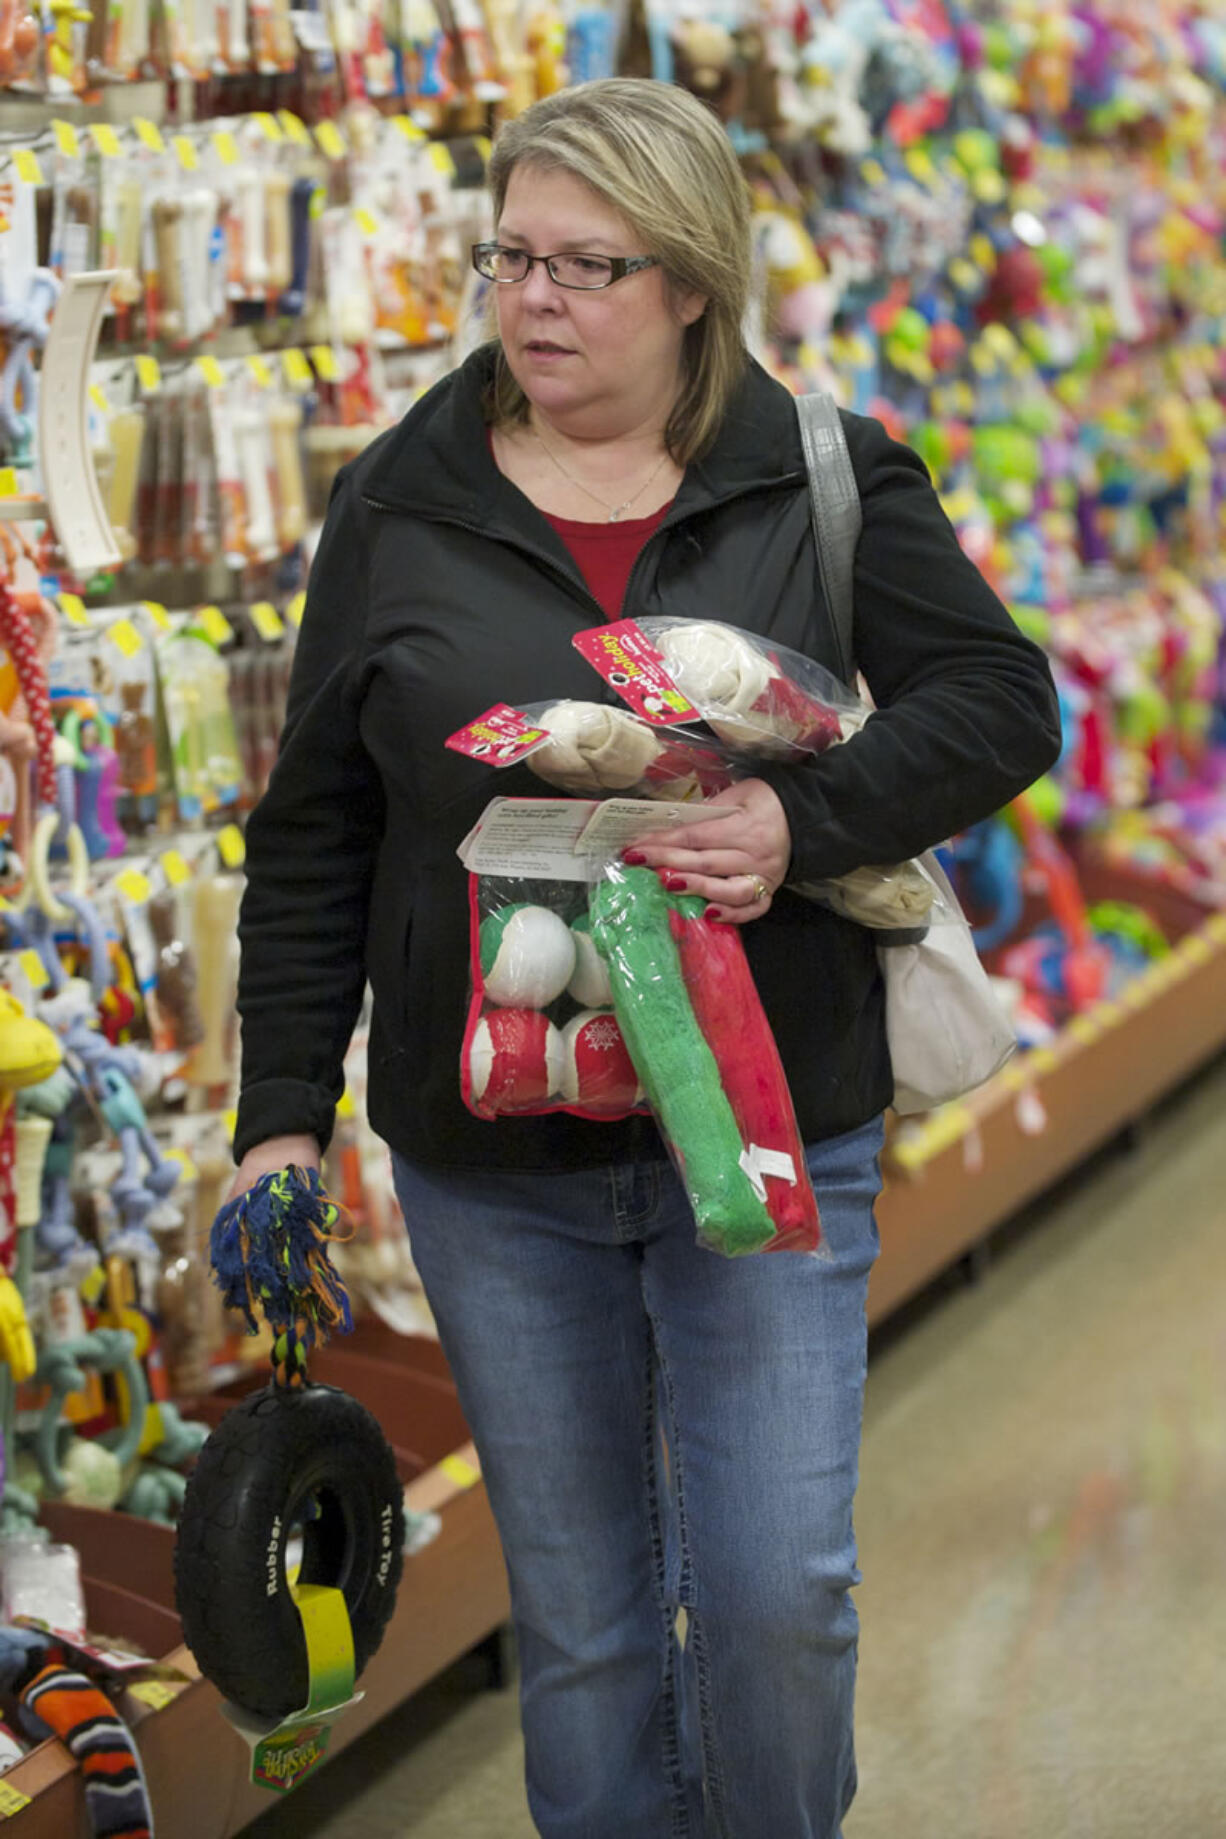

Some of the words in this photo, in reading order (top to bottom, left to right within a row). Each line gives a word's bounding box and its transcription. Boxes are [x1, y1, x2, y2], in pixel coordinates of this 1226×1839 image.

[381, 1503, 393, 1548] Tire
[265, 1514, 282, 1598] Rubber
[375, 1550, 393, 1587] Toy
